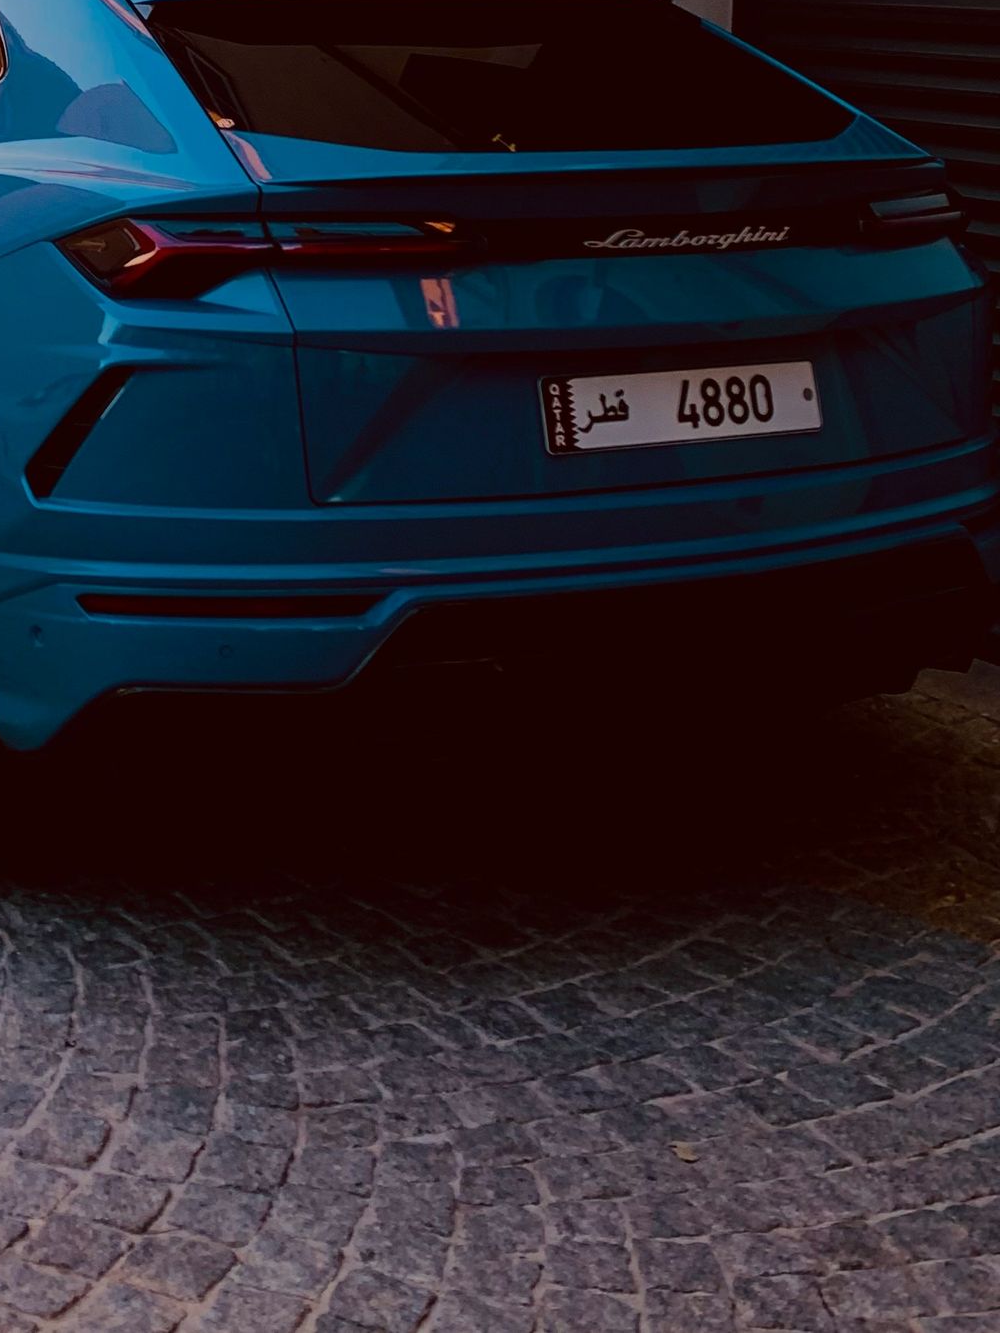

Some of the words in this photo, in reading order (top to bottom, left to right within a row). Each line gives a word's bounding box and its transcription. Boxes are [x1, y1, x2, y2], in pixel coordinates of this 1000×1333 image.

[583, 226, 791, 250] Lamborghini
[549, 383, 568, 447] QATAR
[577, 389, 630, 433] قطر
[677, 374, 774, 429] 4880
